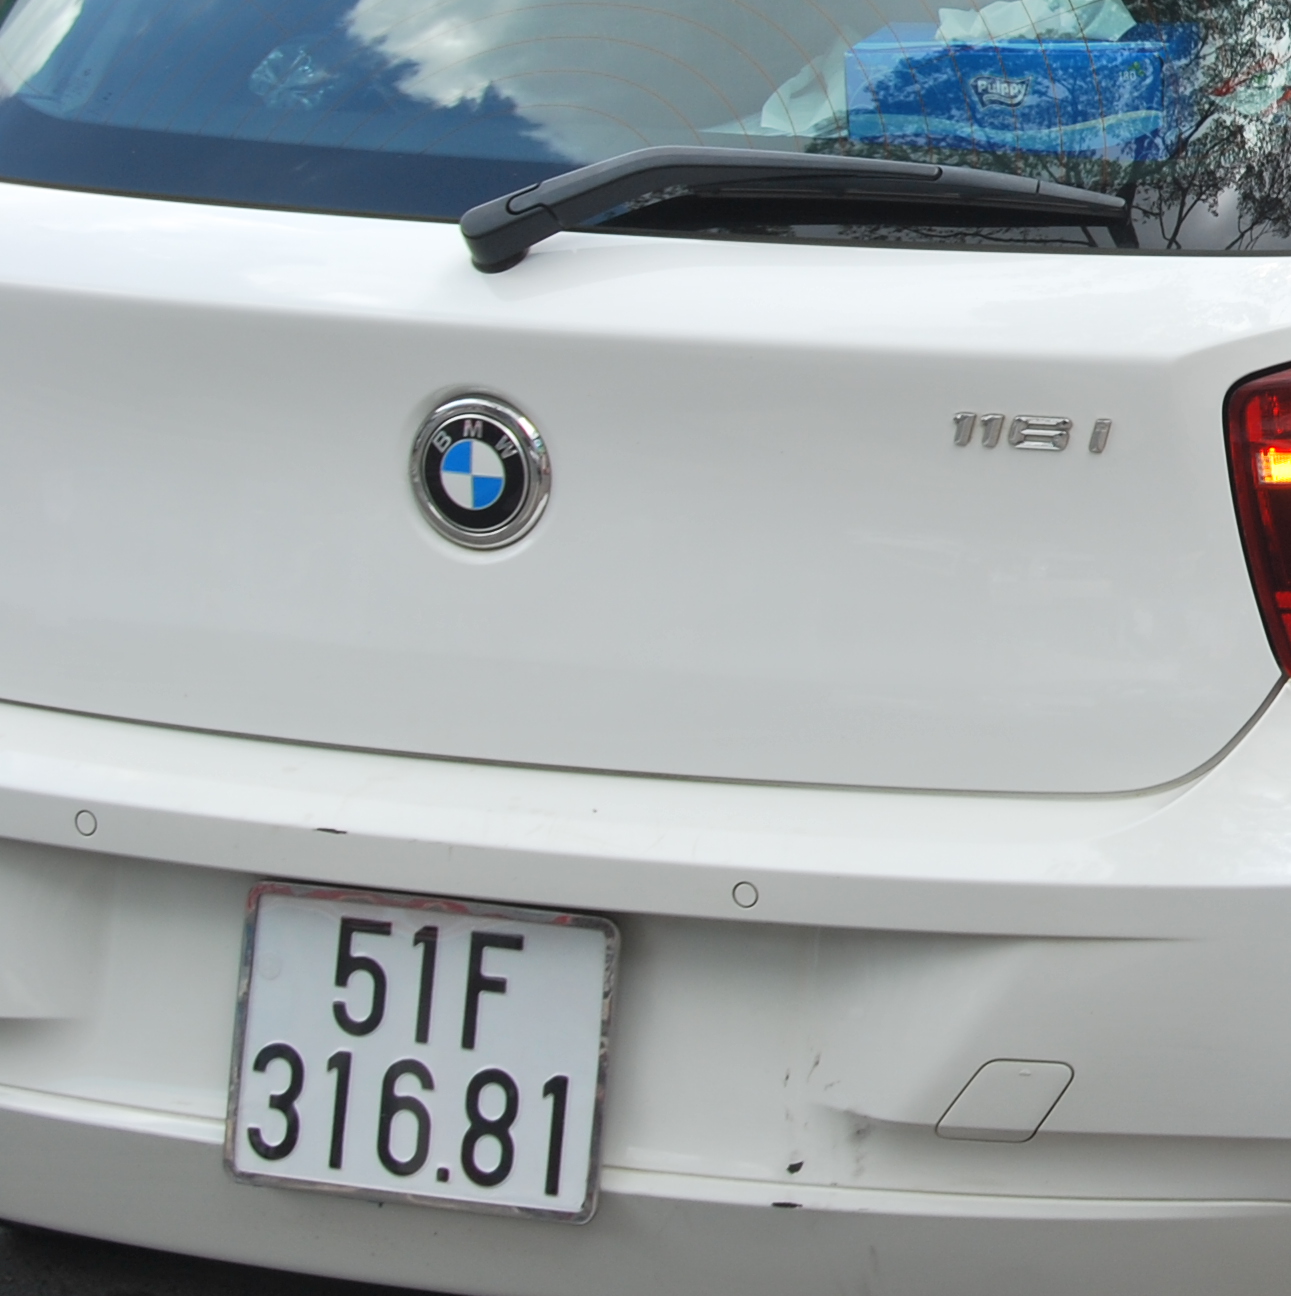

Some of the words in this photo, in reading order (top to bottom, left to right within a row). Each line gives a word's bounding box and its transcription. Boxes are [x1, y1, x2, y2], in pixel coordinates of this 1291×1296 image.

[977, 79, 1026, 96] Pulppy
[432, 419, 518, 460] BMW
[331, 915, 525, 1051] 51F
[246, 1042, 571, 1197] 316.81
